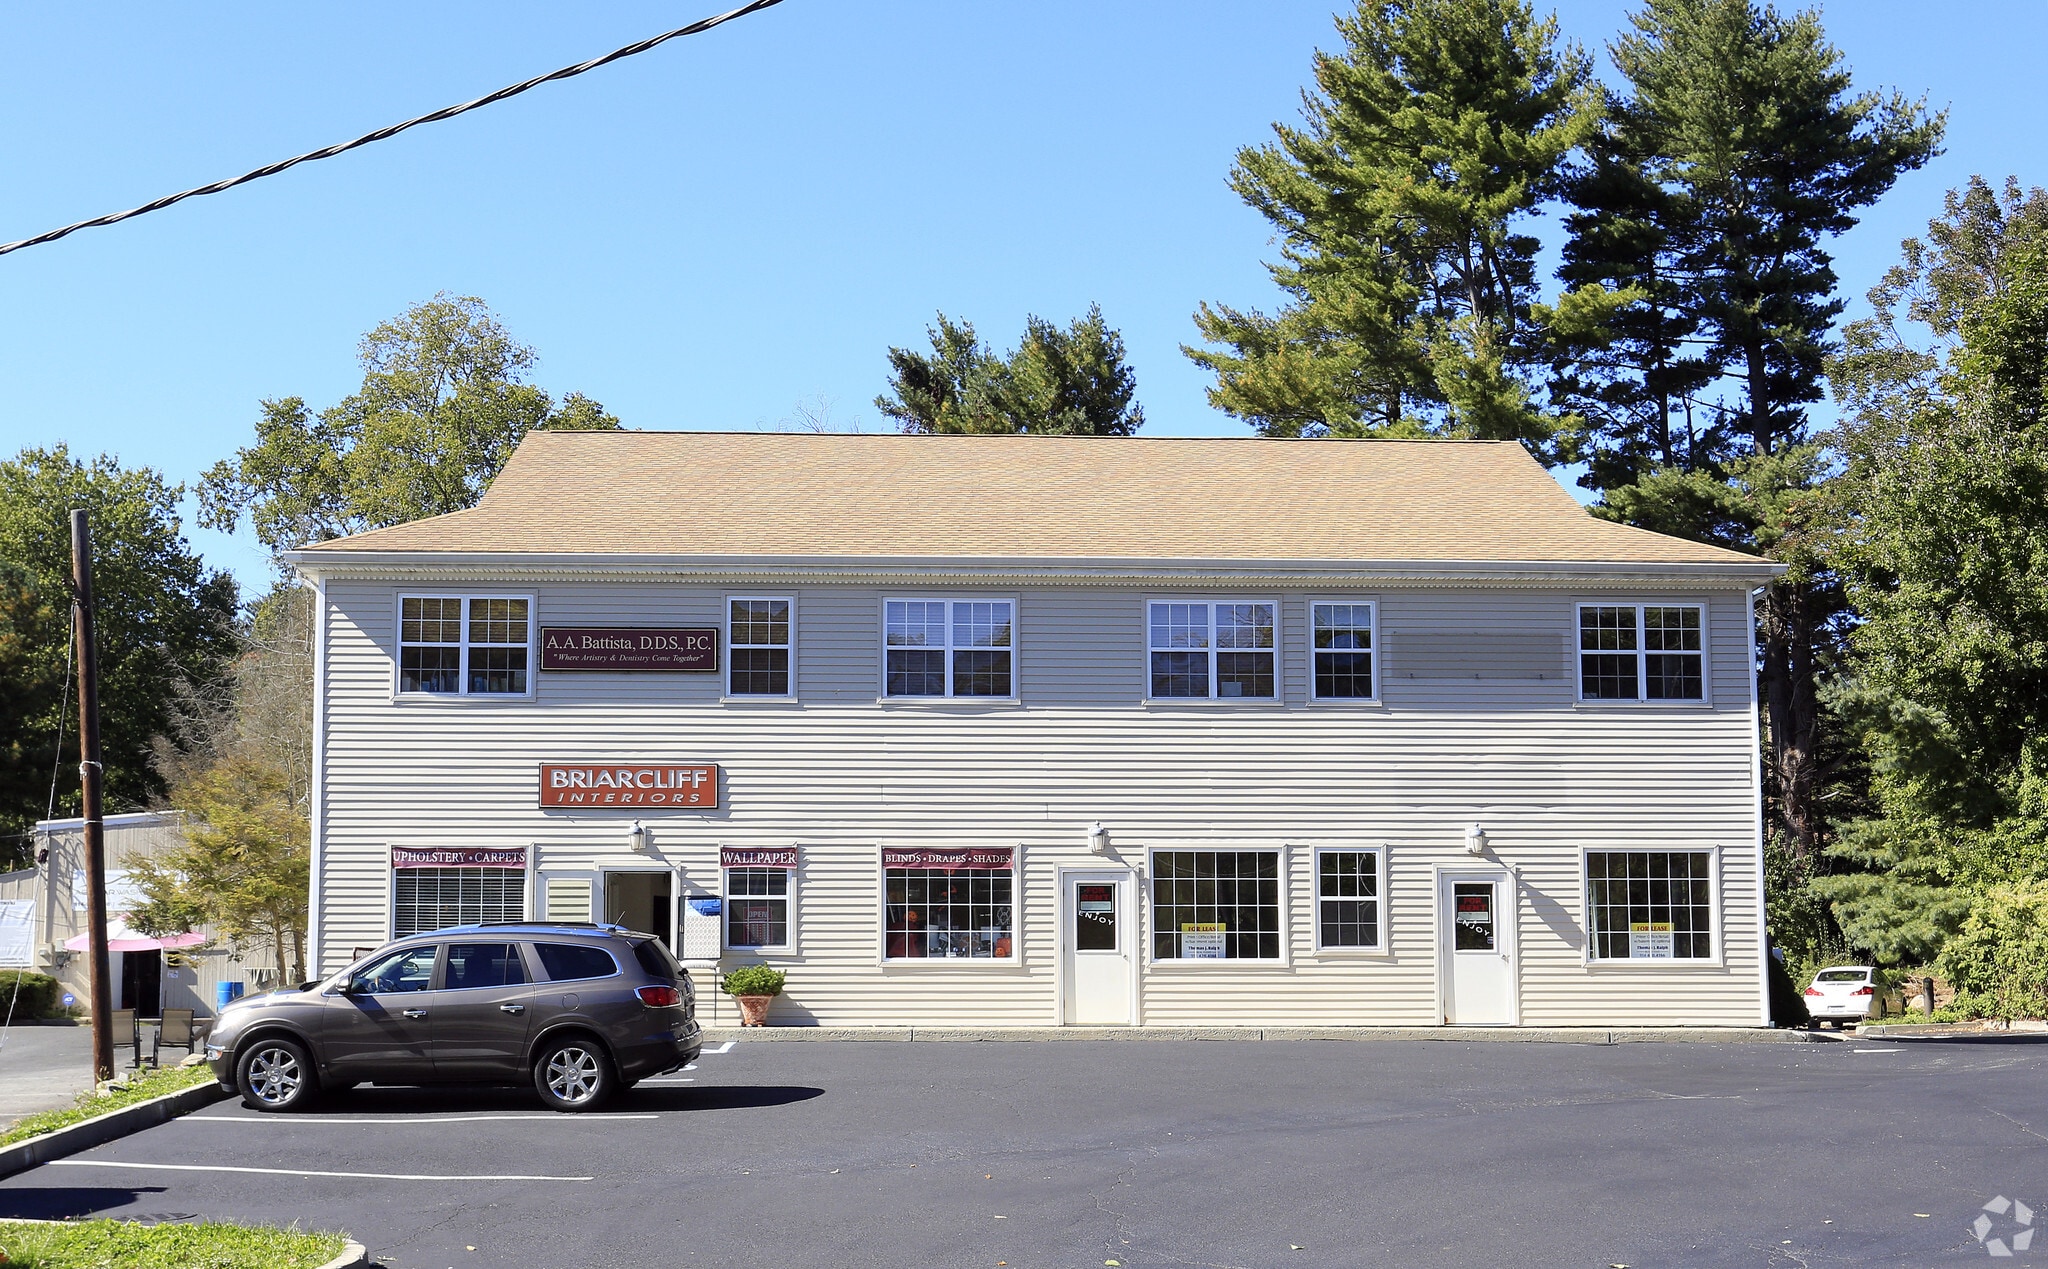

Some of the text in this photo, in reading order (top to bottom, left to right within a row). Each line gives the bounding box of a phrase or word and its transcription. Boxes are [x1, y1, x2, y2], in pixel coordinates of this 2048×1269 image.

[546, 635, 712, 652] A.A. Battista, D.D.S., P.C.
[581, 653, 608, 663] Artistry
[609, 654, 617, 662] &
[619, 654, 650, 663] Dentistry
[652, 654, 671, 662] Come
[550, 769, 708, 789] BRIARCLIFF
[557, 792, 701, 803] INTERIORS
[392, 851, 526, 863] UPHOLSTERY CARPETS
[722, 852, 797, 864] WALLPAPER
[885, 854, 1011, 863] BLINDS DRAPES SHADES
[1078, 910, 1114, 926] ENJOY
